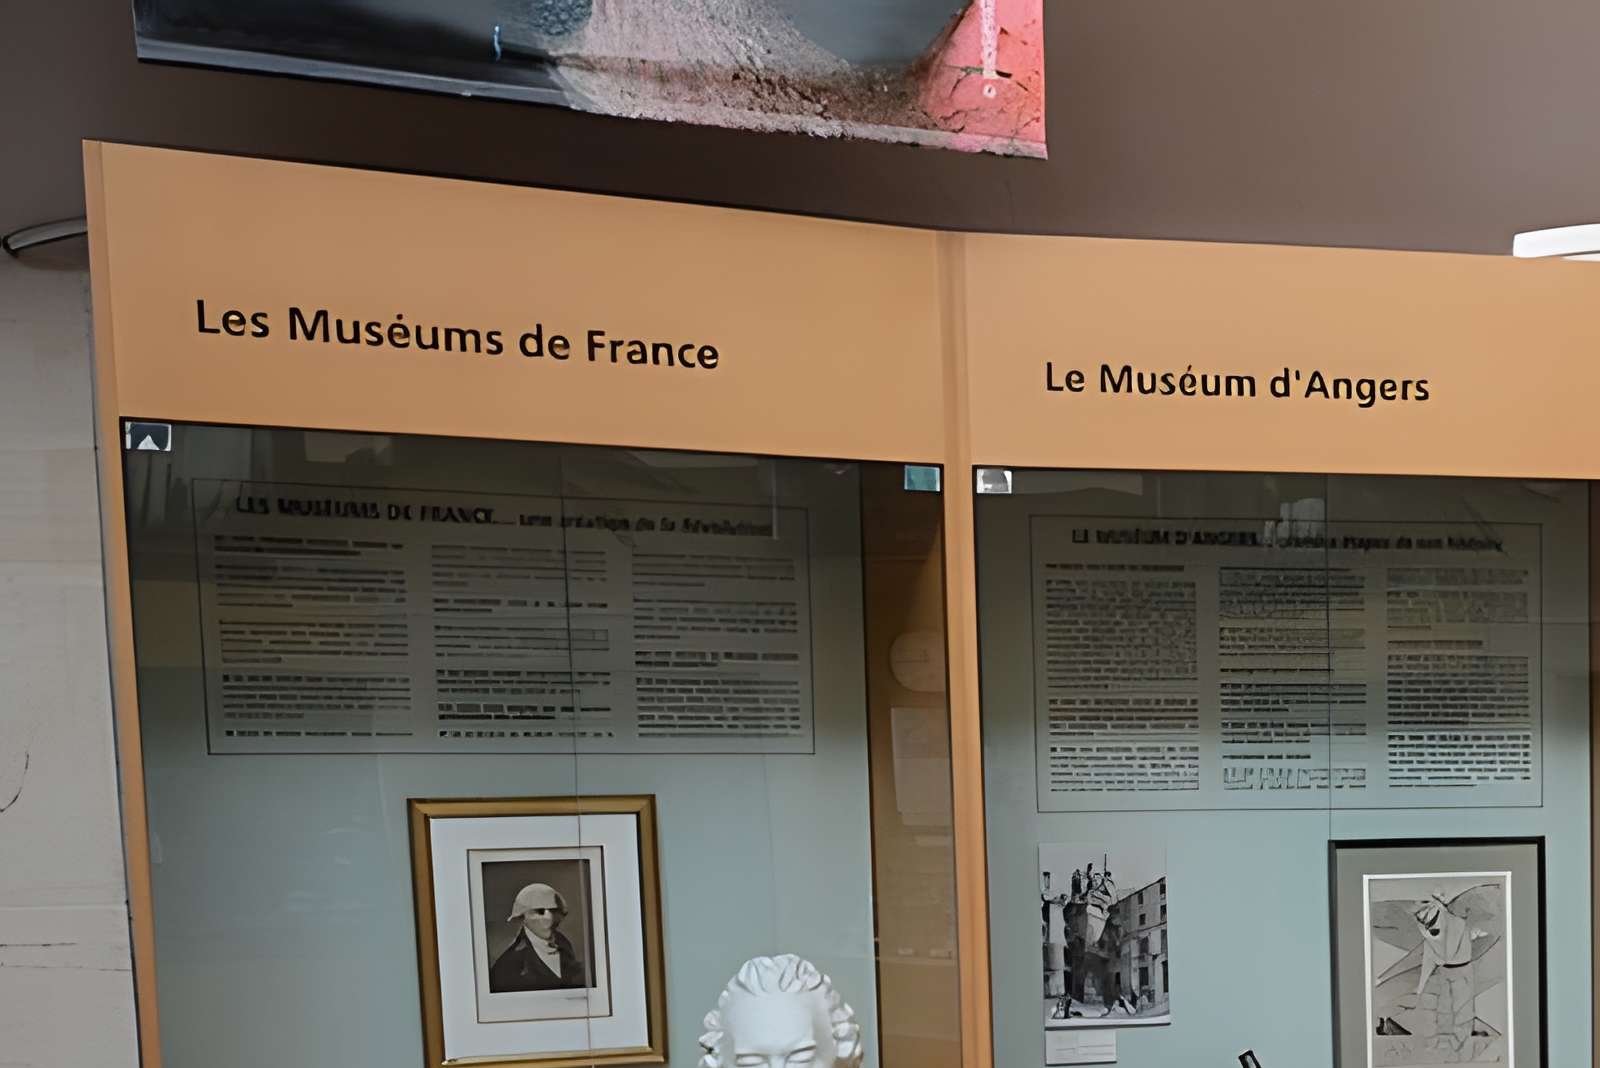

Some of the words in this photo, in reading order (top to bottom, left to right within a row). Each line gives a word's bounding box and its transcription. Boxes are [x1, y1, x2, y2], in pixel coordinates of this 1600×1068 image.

[196, 299, 270, 339] Les
[288, 306, 504, 356] Muséums
[518, 323, 571, 361] de
[587, 329, 719, 370] France
[1046, 361, 1085, 393] Le
[1100, 363, 1256, 398] Muséum
[1269, 367, 1430, 409] d'Angers
